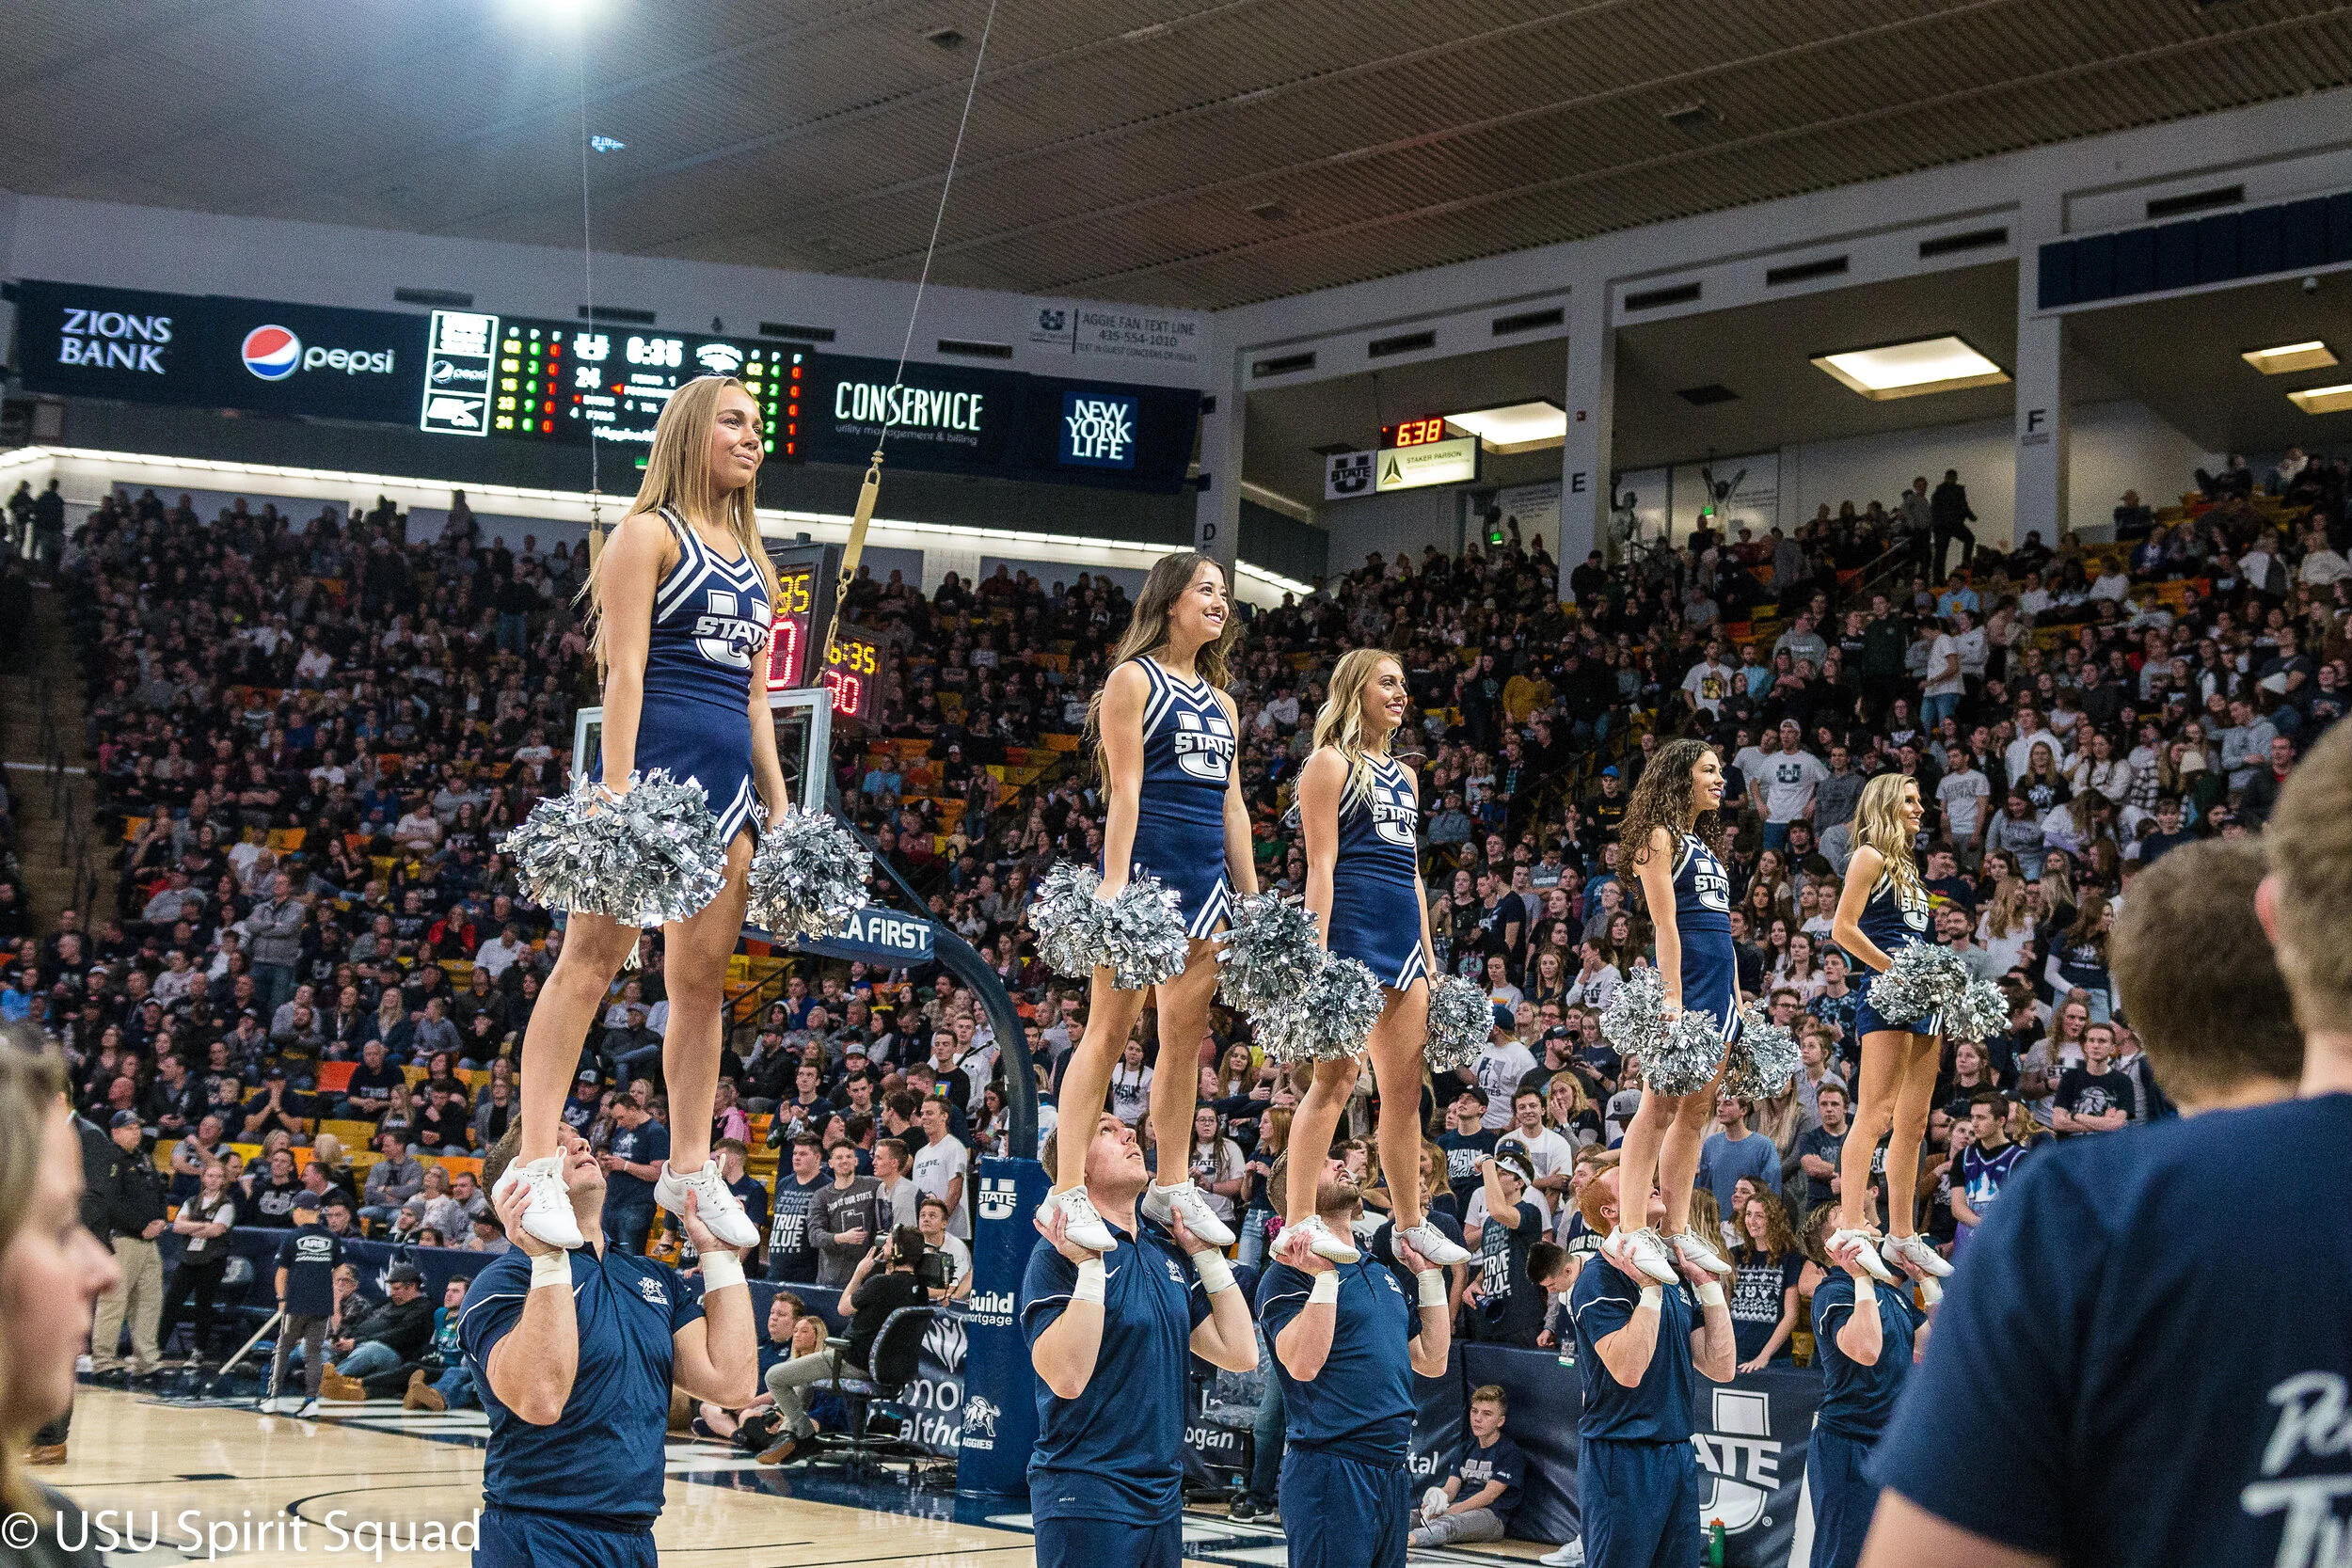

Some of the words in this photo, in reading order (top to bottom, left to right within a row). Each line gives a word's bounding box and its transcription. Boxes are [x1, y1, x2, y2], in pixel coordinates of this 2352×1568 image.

[60, 308, 173, 343] ZIONS
[1083, 313, 1116, 327] AGGIE
[1120, 316, 1140, 329] FAN
[1145, 319, 1169, 333] TEXT
[1172, 322, 1196, 336] LINE
[57, 337, 166, 375] BANK
[303, 346, 395, 376] pepsi
[549, 343, 561, 357] 0
[548, 362, 559, 376] 0
[791, 366, 802, 380] 0
[790, 385, 801, 399] 0
[544, 400, 555, 415] 0
[788, 404, 799, 417] 0
[835, 382, 983, 432] CONSERVICE
[1074, 399, 1128, 420] NEW
[542, 420, 553, 434] 0
[787, 422, 797, 436] 1
[1065, 415, 1132, 444] YORK
[2027, 408, 2046, 433] F
[1396, 419, 1443, 448] 6:38
[787, 442, 795, 454] 1
[1072, 436, 1124, 460] LIFE
[1406, 454, 1433, 465] STAKER
[1434, 451, 1463, 461] PARSON
[1330, 466, 1372, 483] STATE
[1572, 472, 1586, 494] E
[1203, 523, 1216, 541] D
[828, 641, 877, 674] 6:35
[1174, 732, 1235, 762] STATE
[1372, 802, 1419, 832] STATE
[1693, 874, 1730, 897] STAT
[867, 917, 931, 951] FIRST
[856, 1190, 873, 1202] STATE
[978, 1178, 1015, 1220] U
[978, 1190, 1018, 1208] STATE
[773, 1213, 806, 1231] TRUE
[769, 1230, 802, 1248] BLUE
[1587, 1233, 1606, 1249] STAT
[1483, 1249, 1510, 1278] TRUE
[969, 1290, 1014, 1314] Guild
[961, 1436, 993, 1450] AGGIES
[1184, 1425, 1234, 1451] ogan
[1690, 1433, 1782, 1490] ATE
